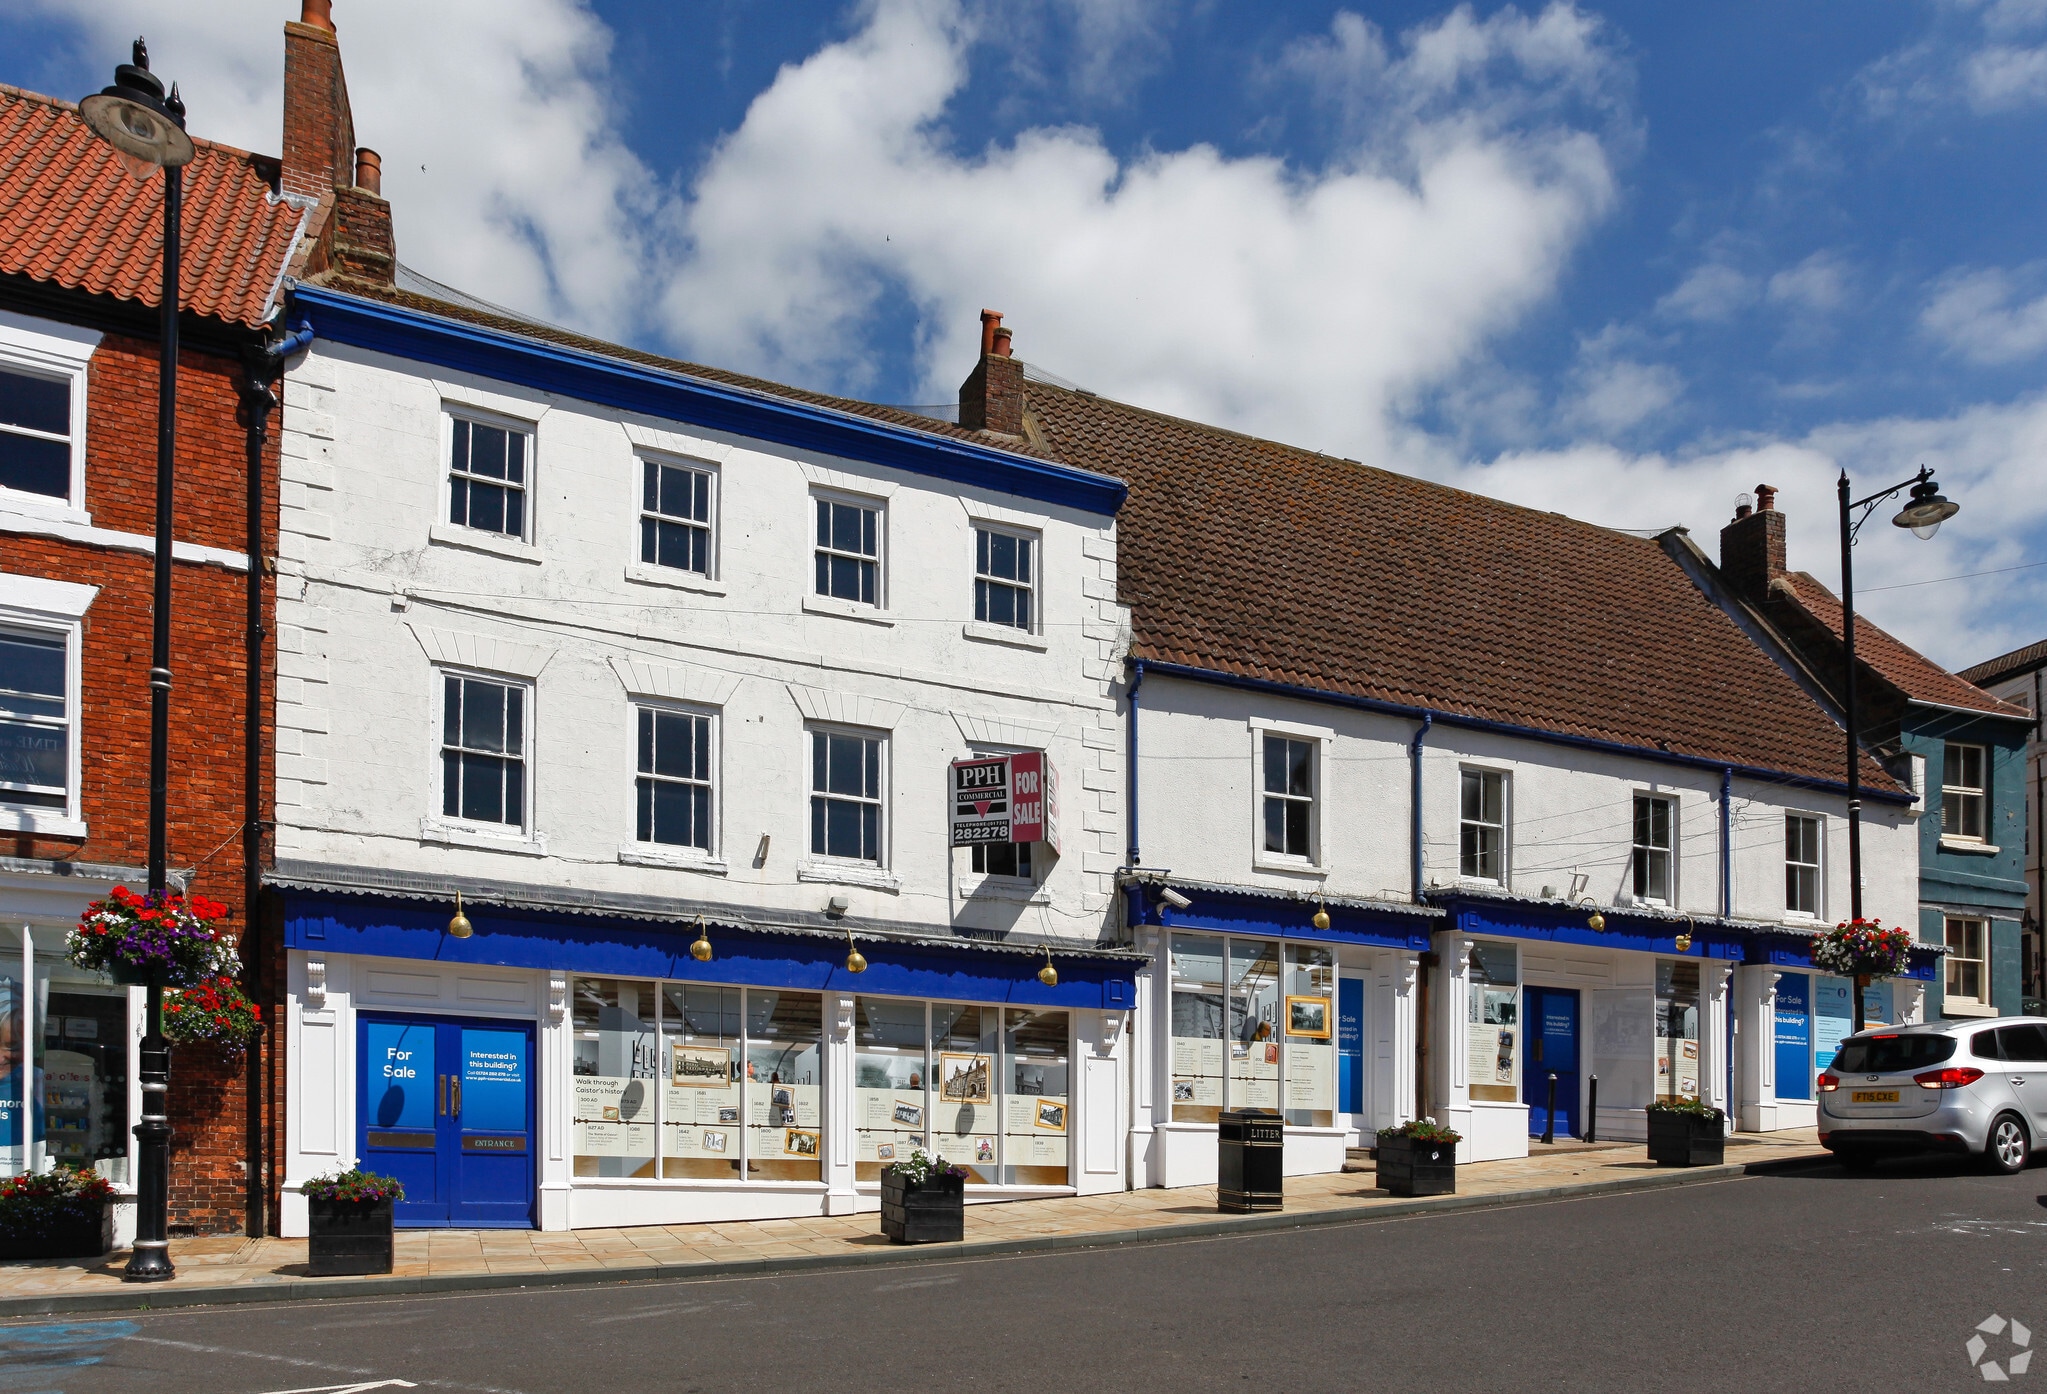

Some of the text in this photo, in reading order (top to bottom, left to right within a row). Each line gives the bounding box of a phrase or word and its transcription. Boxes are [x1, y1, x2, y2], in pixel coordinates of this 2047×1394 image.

[961, 765, 1001, 787] PPH
[1015, 771, 1039, 795] FOR
[959, 791, 1005, 801] COMMERCIAL
[1014, 801, 1041, 825] SALE
[955, 826, 1008, 840] 282278
[1776, 994, 1802, 1005] For Sale
[1342, 1014, 1356, 1023] Sale
[387, 1047, 413, 1061] For
[470, 1051, 509, 1060] Interested
[469, 1060, 517, 1071] this building?
[383, 1064, 416, 1079] Sale
[593, 1079, 619, 1088] through
[575, 1086, 628, 1096] Caistor's history
[1856, 1091, 1894, 1101] FT15 CXE
[1250, 1128, 1281, 1139] LITTER
[474, 1139, 515, 1148] ENTRANCE
